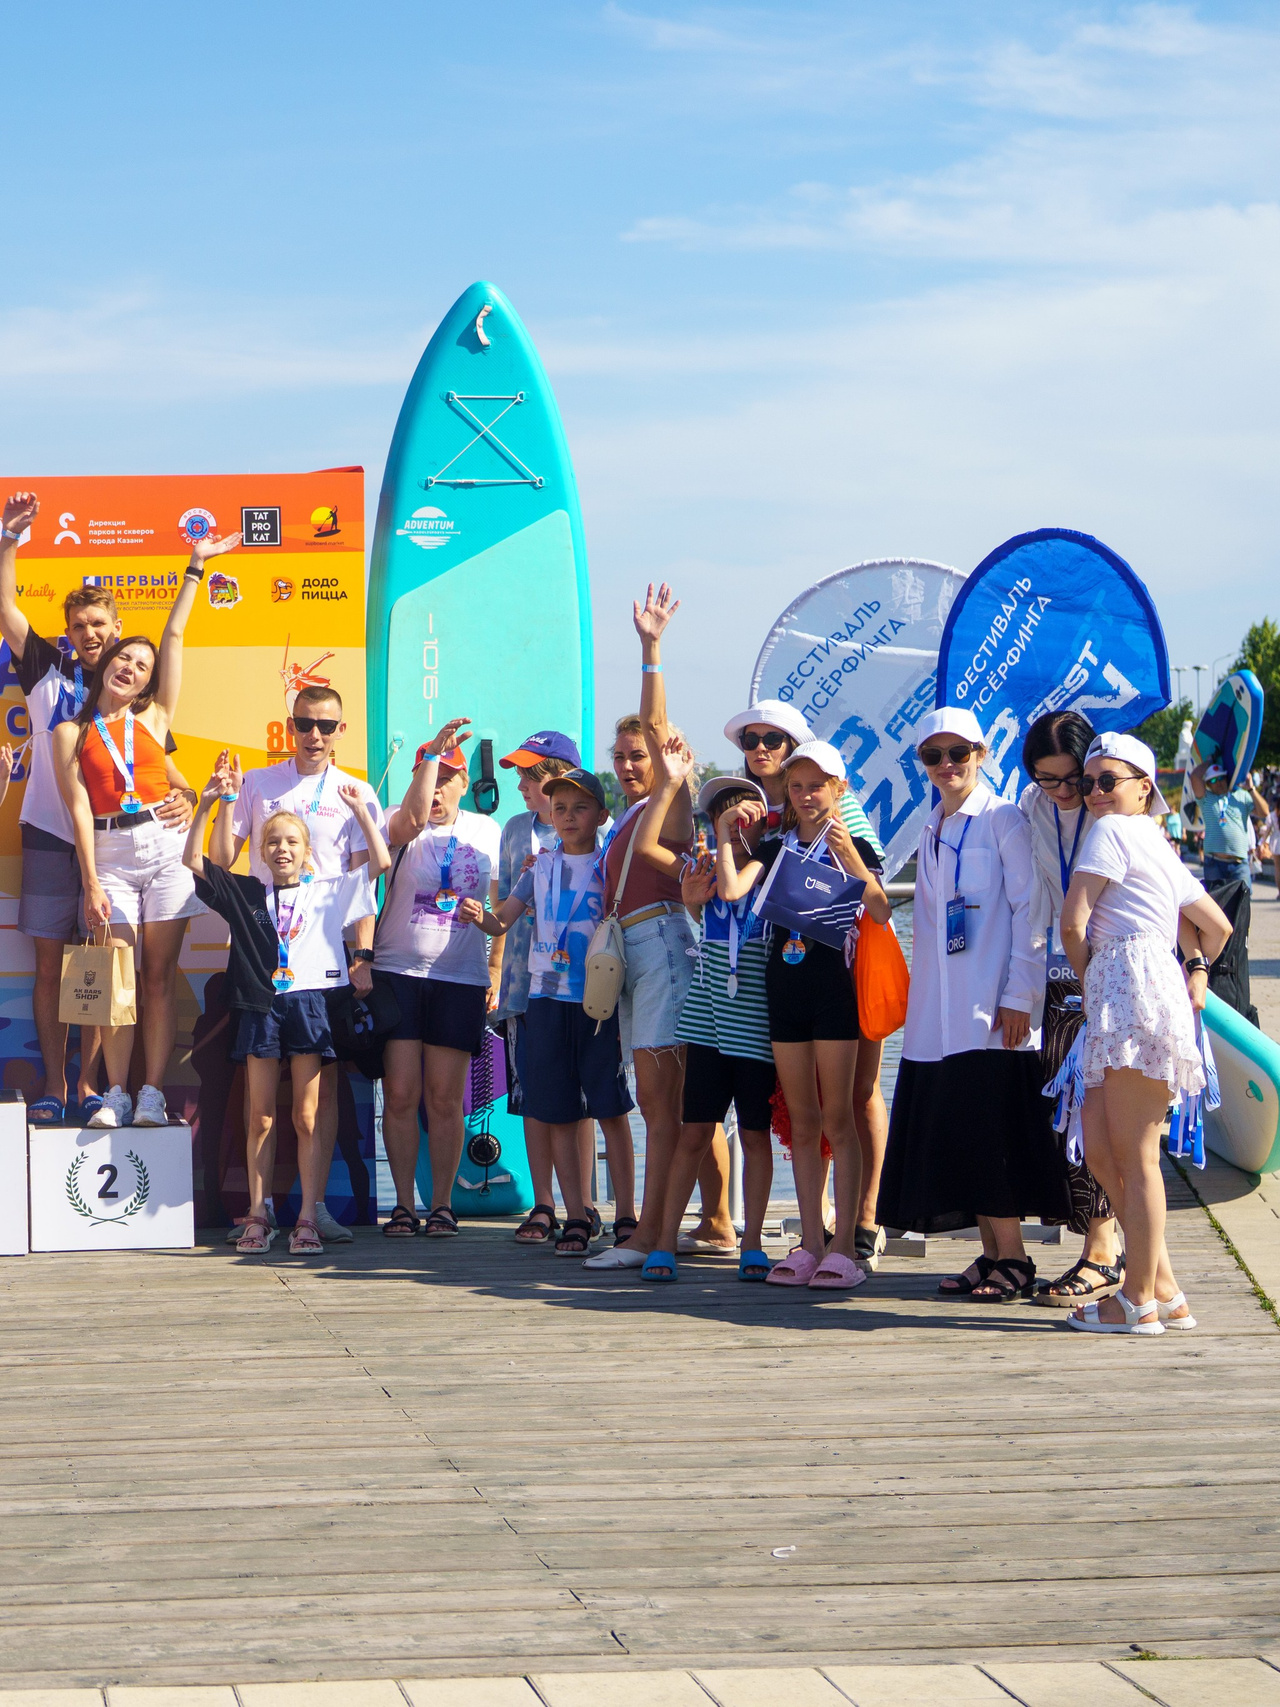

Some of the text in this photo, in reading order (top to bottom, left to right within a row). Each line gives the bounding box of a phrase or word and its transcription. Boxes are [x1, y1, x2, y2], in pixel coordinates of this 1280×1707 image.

[252, 512, 269, 521] TAT
[88, 519, 126, 527] Дирекция
[251, 522, 271, 531] PRO
[404, 520, 454, 530] ADVENTUM
[252, 533, 270, 542] KAT
[102, 571, 178, 587] ПЕРВЫЙ
[302, 578, 339, 589] ДОДО
[25, 583, 56, 602] daily
[302, 591, 348, 602] ПИЦЦА
[955, 576, 1032, 701] ФЕСТИВАЛЬ
[777, 598, 882, 703] ФЕСТИВАЛЬ
[947, 936, 965, 952] ORG
[97, 1164, 119, 1199] 2
